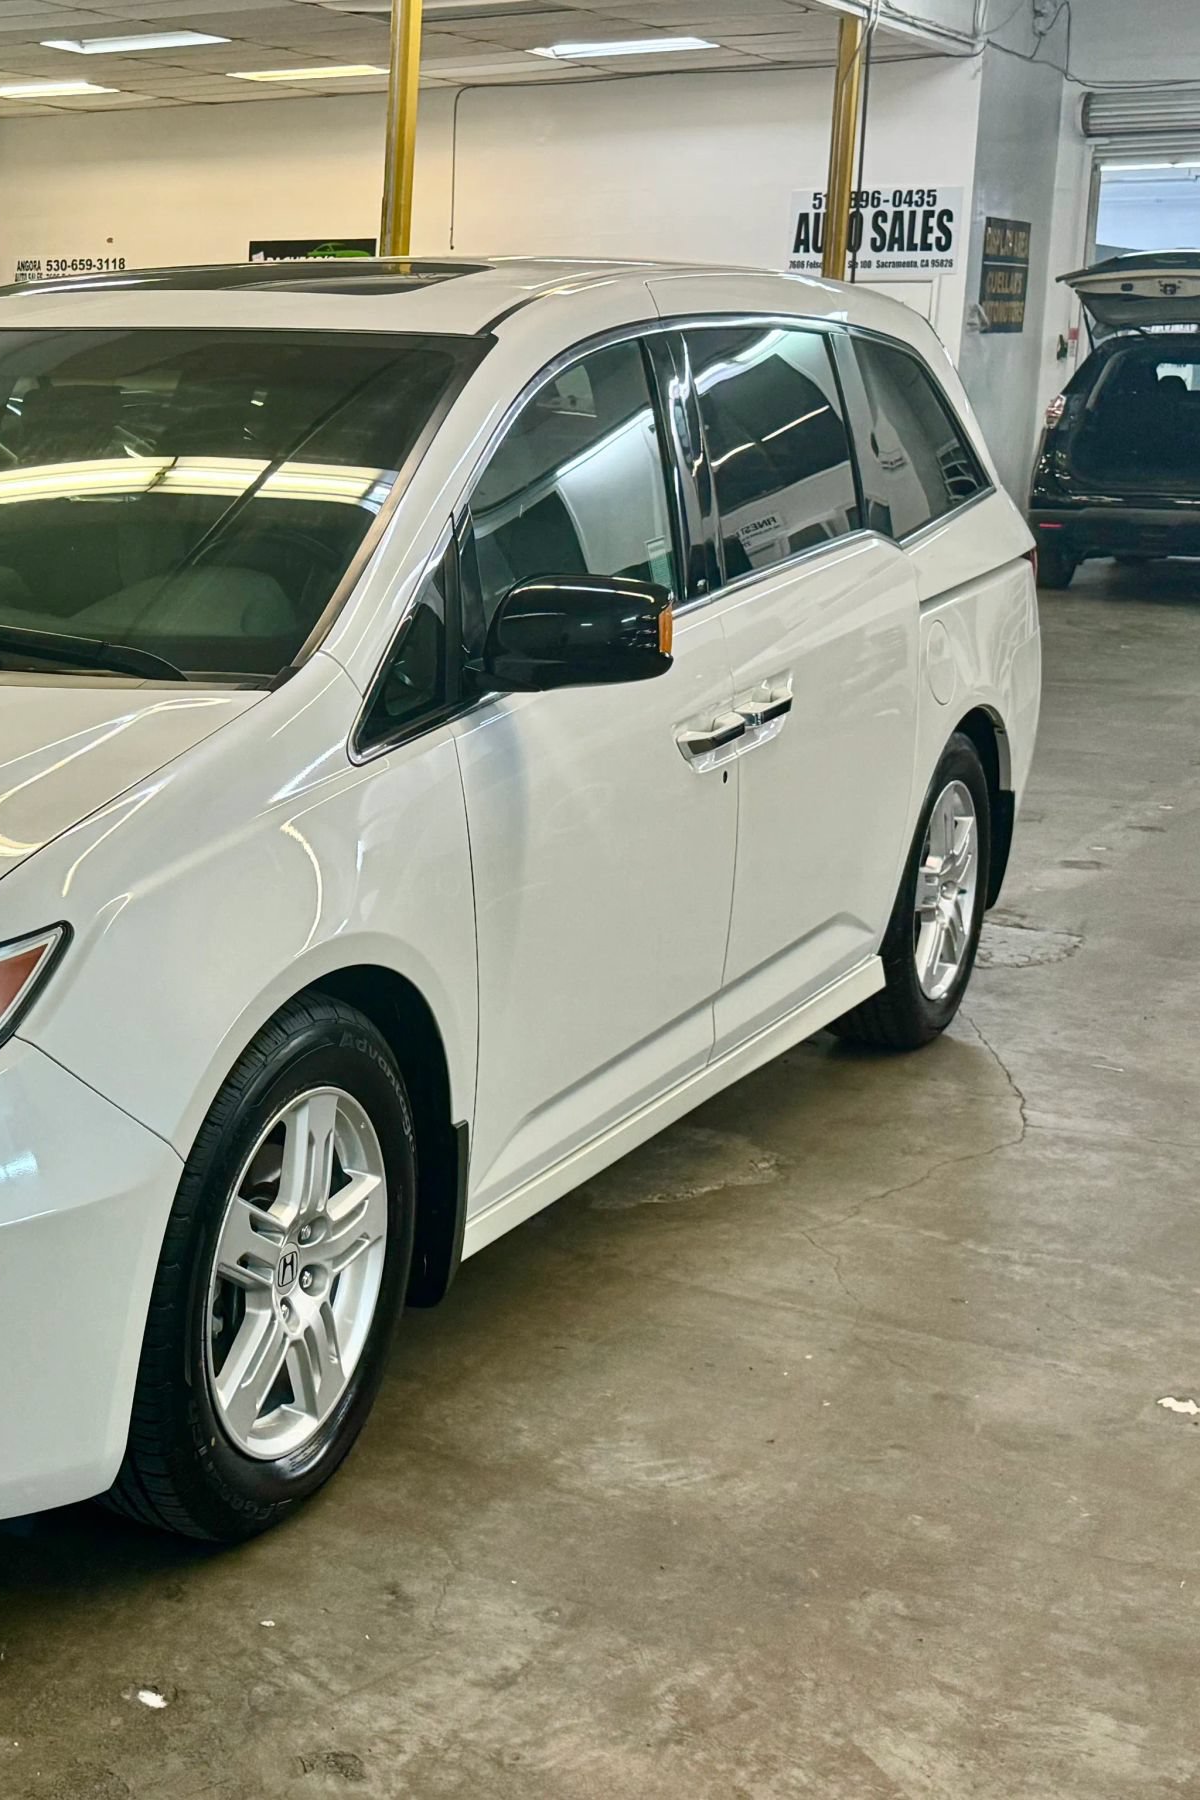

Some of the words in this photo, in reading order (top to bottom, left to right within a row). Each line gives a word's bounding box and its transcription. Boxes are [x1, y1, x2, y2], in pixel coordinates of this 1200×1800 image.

[793, 210, 863, 253] AUO
[870, 209, 953, 252] SALES
[17, 260, 41, 271] ANGORA
[46, 258, 125, 272] 530-659-3118
[920, 260, 929, 268] CA
